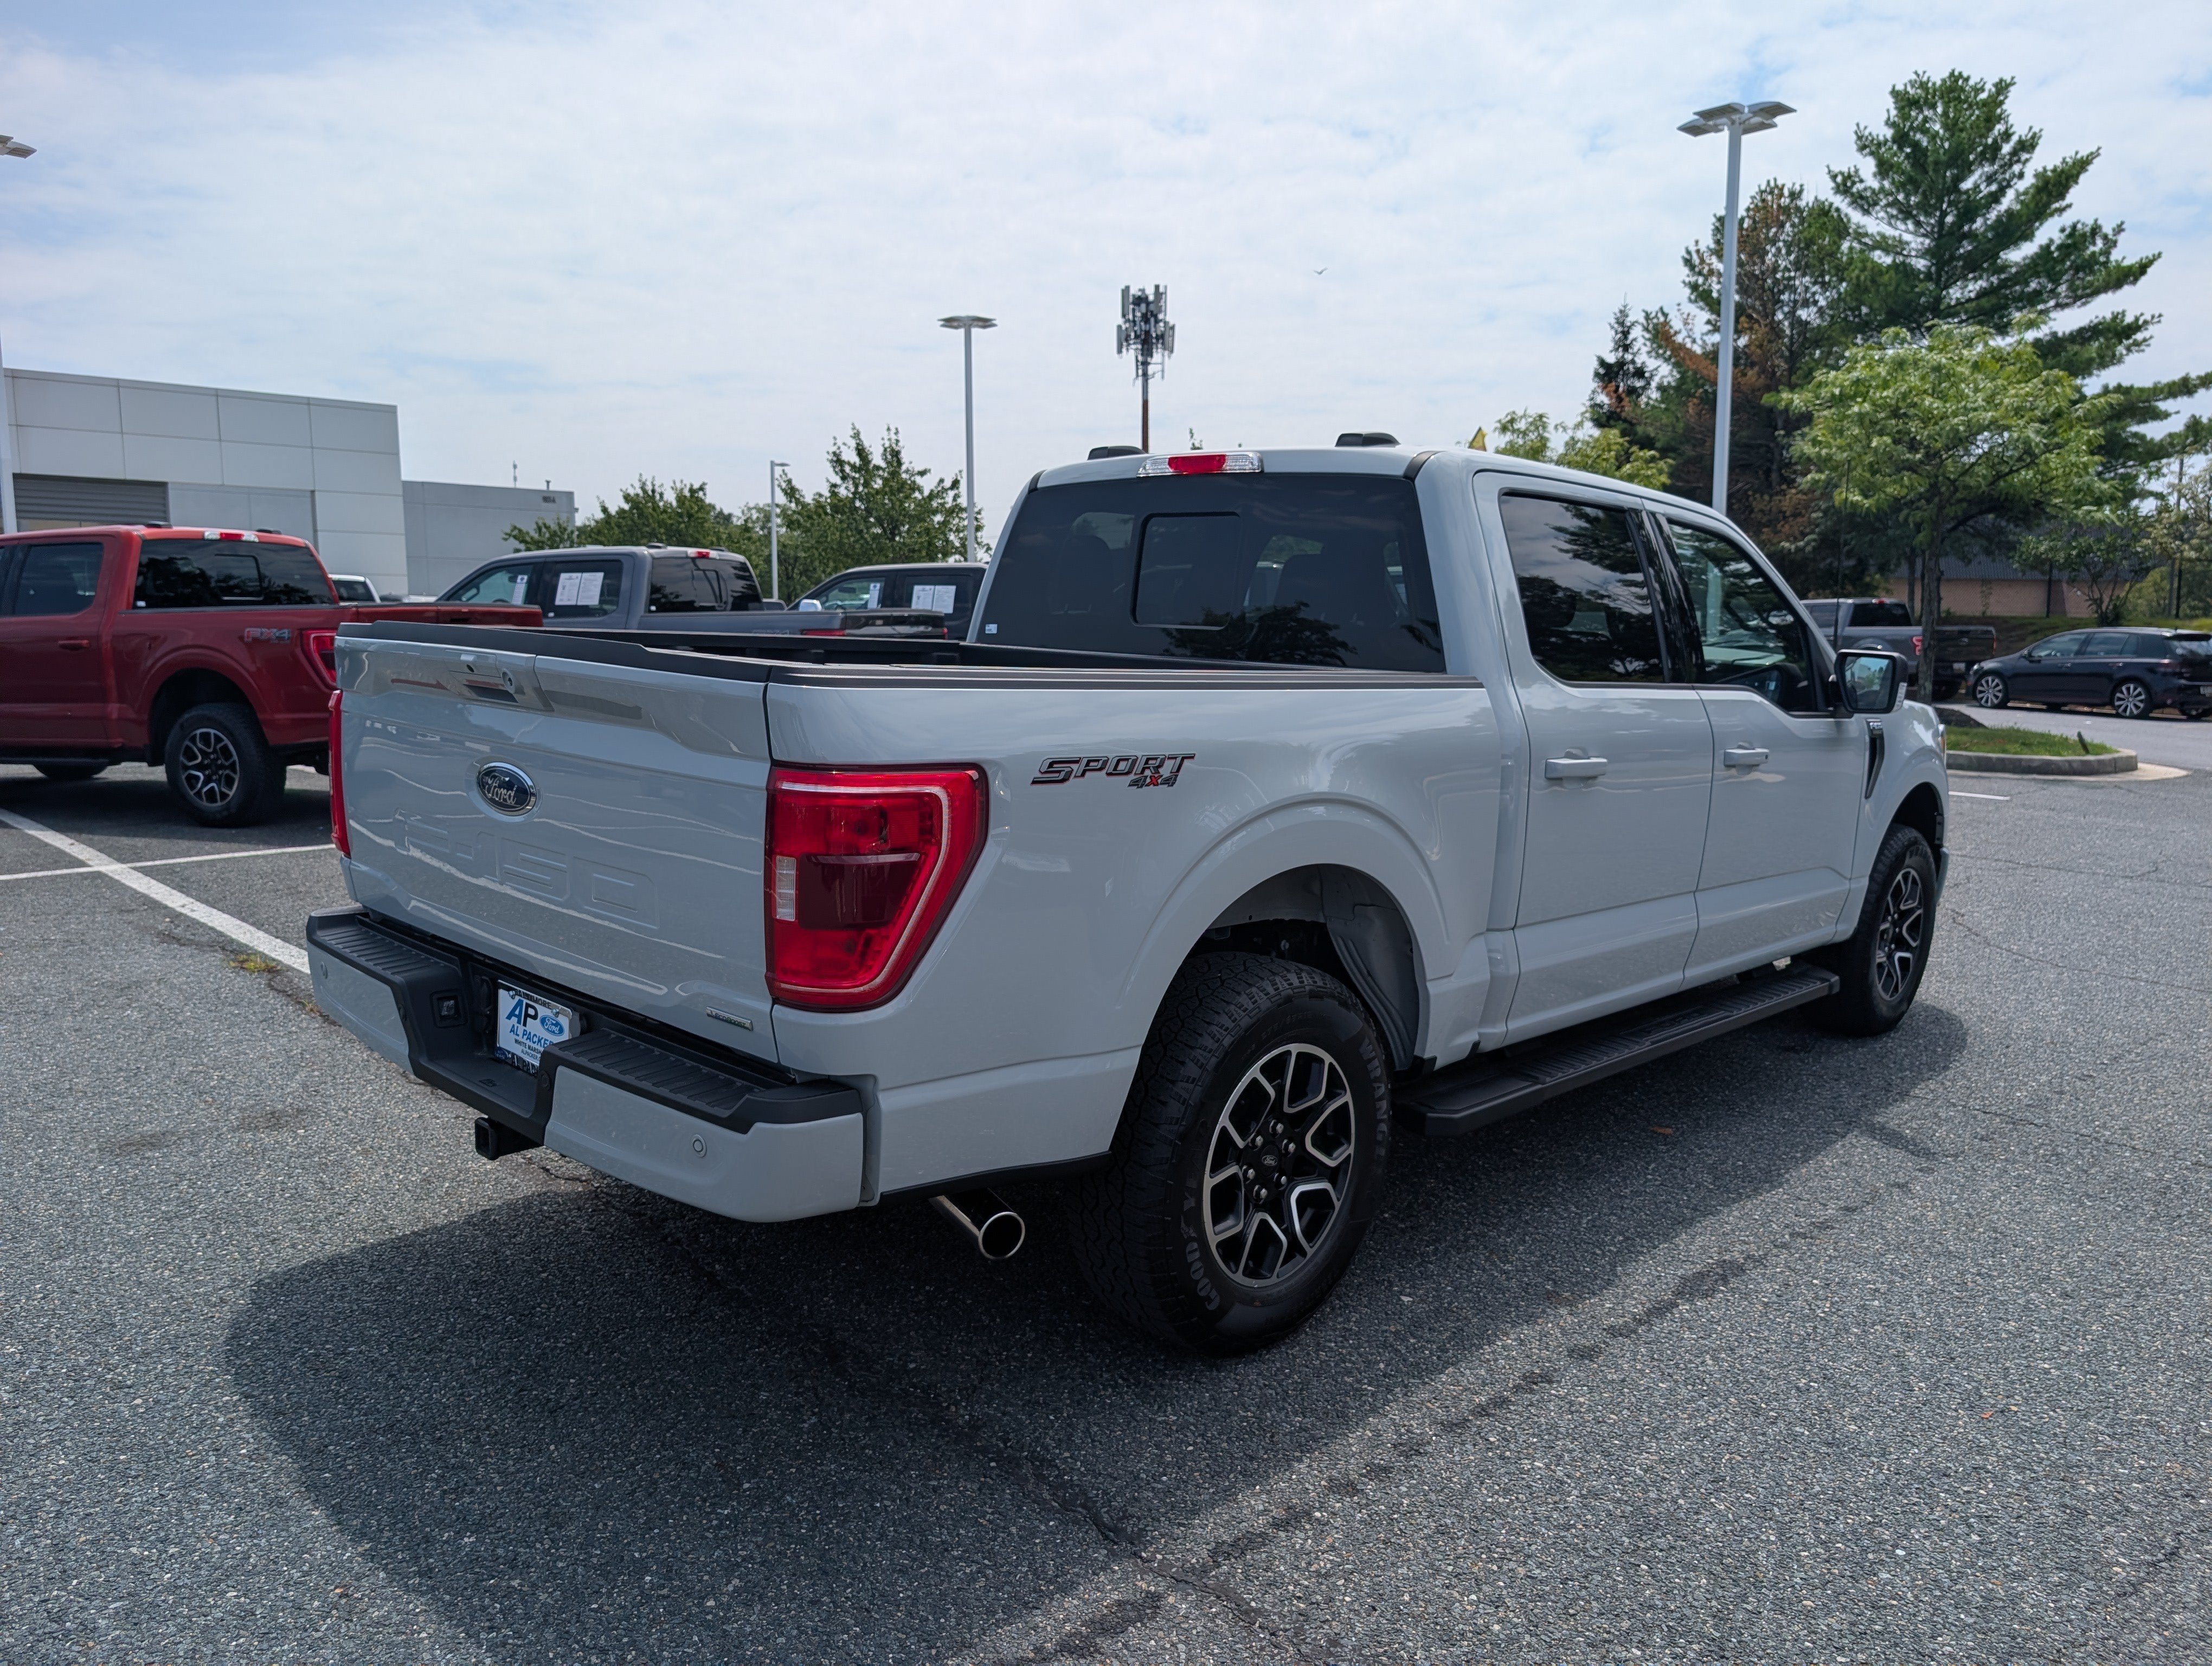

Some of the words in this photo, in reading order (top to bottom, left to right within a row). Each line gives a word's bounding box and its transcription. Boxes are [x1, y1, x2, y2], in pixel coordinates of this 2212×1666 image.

[245, 628, 291, 642] FX4
[1030, 753, 1197, 785] SPORT
[505, 998, 539, 1028] AP
[509, 1024, 520, 1037] AL
[543, 1016, 560, 1034] Ford
[515, 1038, 527, 1049] WHITE
